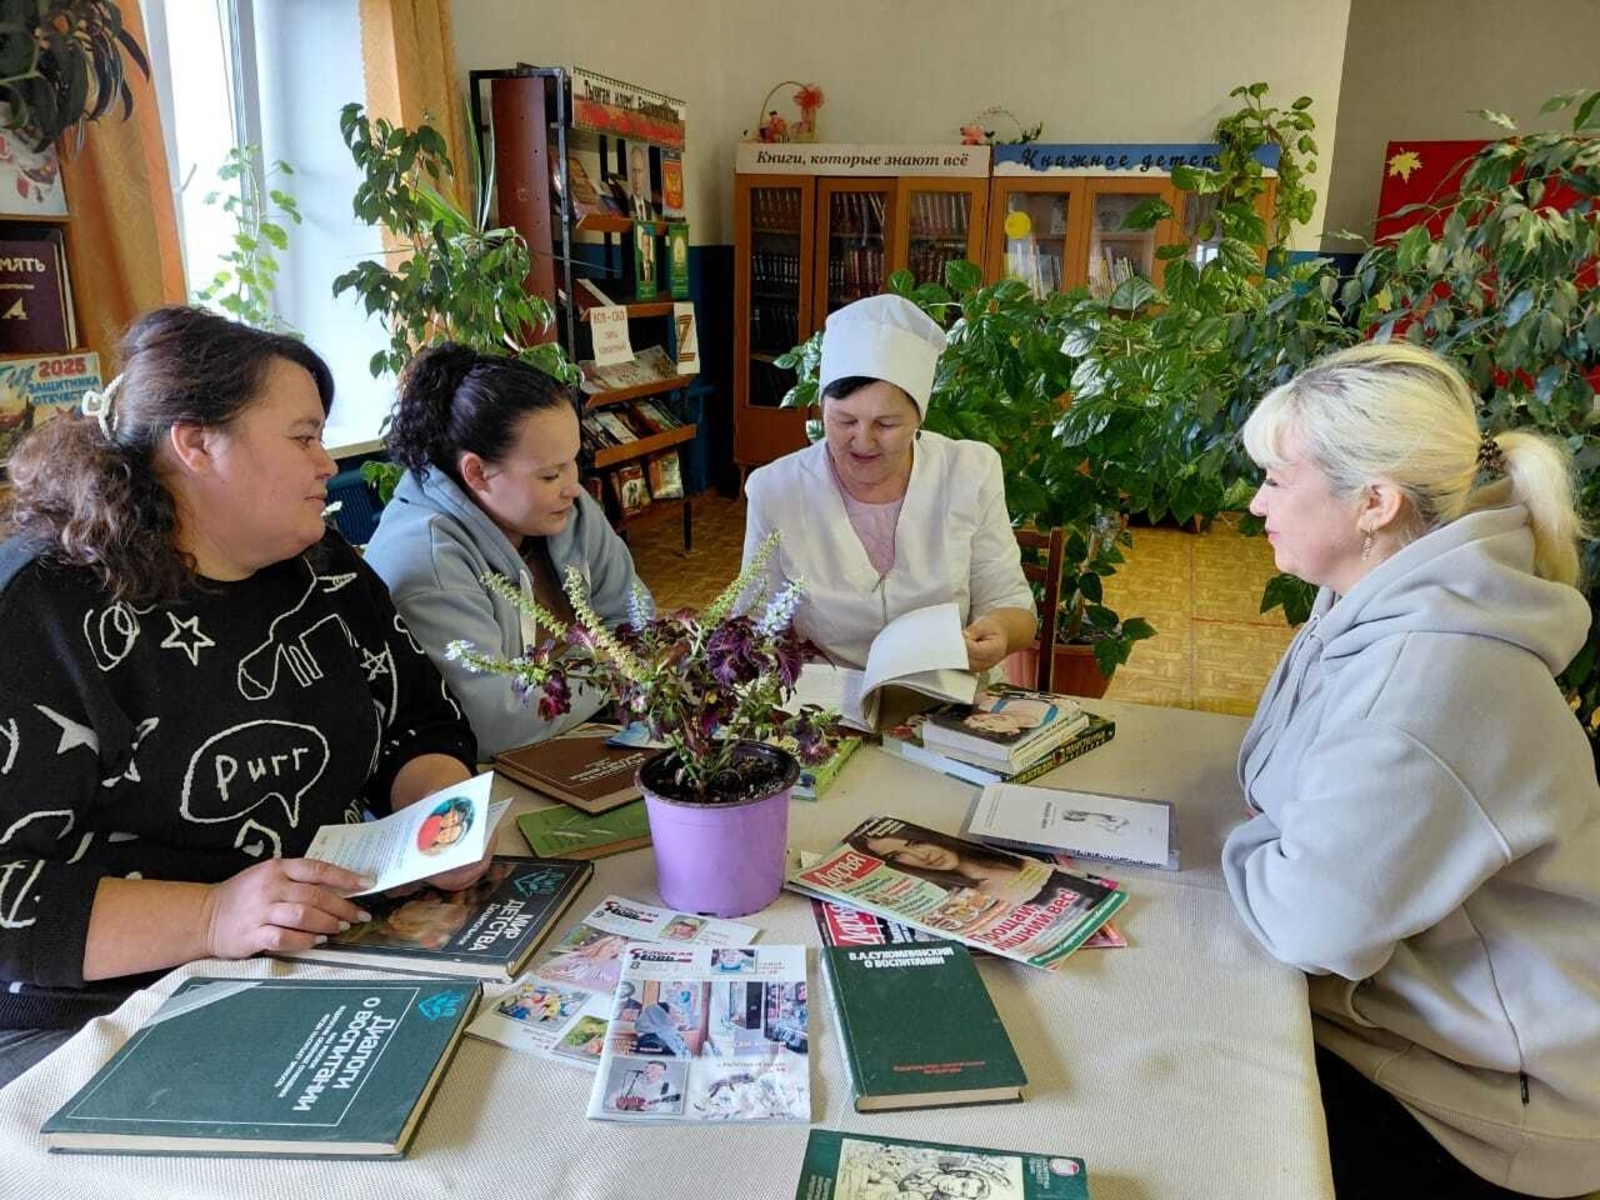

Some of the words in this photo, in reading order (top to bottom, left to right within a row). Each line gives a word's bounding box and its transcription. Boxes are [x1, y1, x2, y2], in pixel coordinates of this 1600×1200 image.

[756, 150, 807, 166] Книги,
[811, 155, 881, 168] которые
[884, 155, 939, 166] знают
[943, 153, 969, 166] всё
[38, 358, 86, 377] 2025
[215, 747, 309, 800] purr
[468, 899, 526, 951] ДЕТСТВА
[503, 914, 534, 939] МИР
[292, 1011, 374, 1111] воспитании
[332, 1015, 396, 1089] Диалоги
